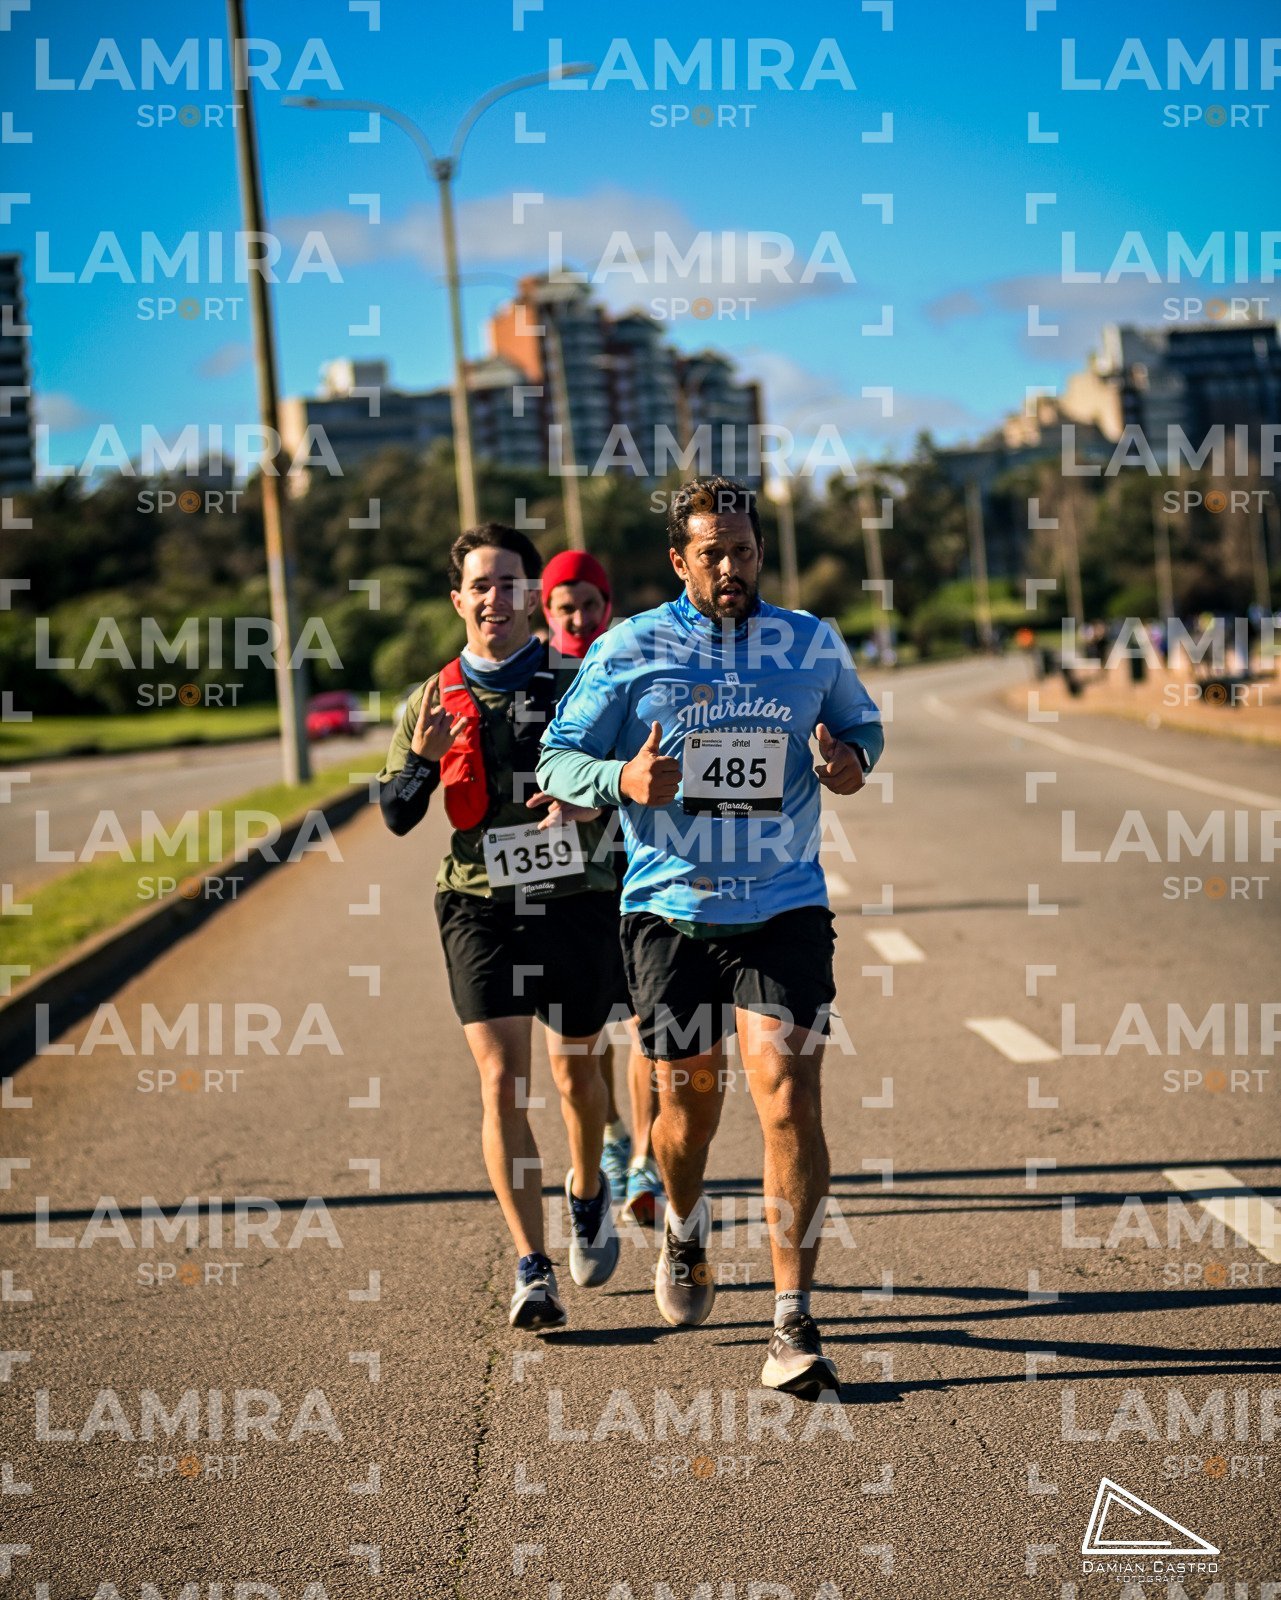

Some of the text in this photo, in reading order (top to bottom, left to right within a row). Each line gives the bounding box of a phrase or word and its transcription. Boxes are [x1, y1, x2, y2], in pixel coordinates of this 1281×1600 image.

[677, 697, 793, 728] Maratón
[694, 726, 783, 734] ONTEVIDEO
[731, 738, 751, 748] antel
[702, 757, 767, 789] 485
[493, 840, 573, 877] 1359
